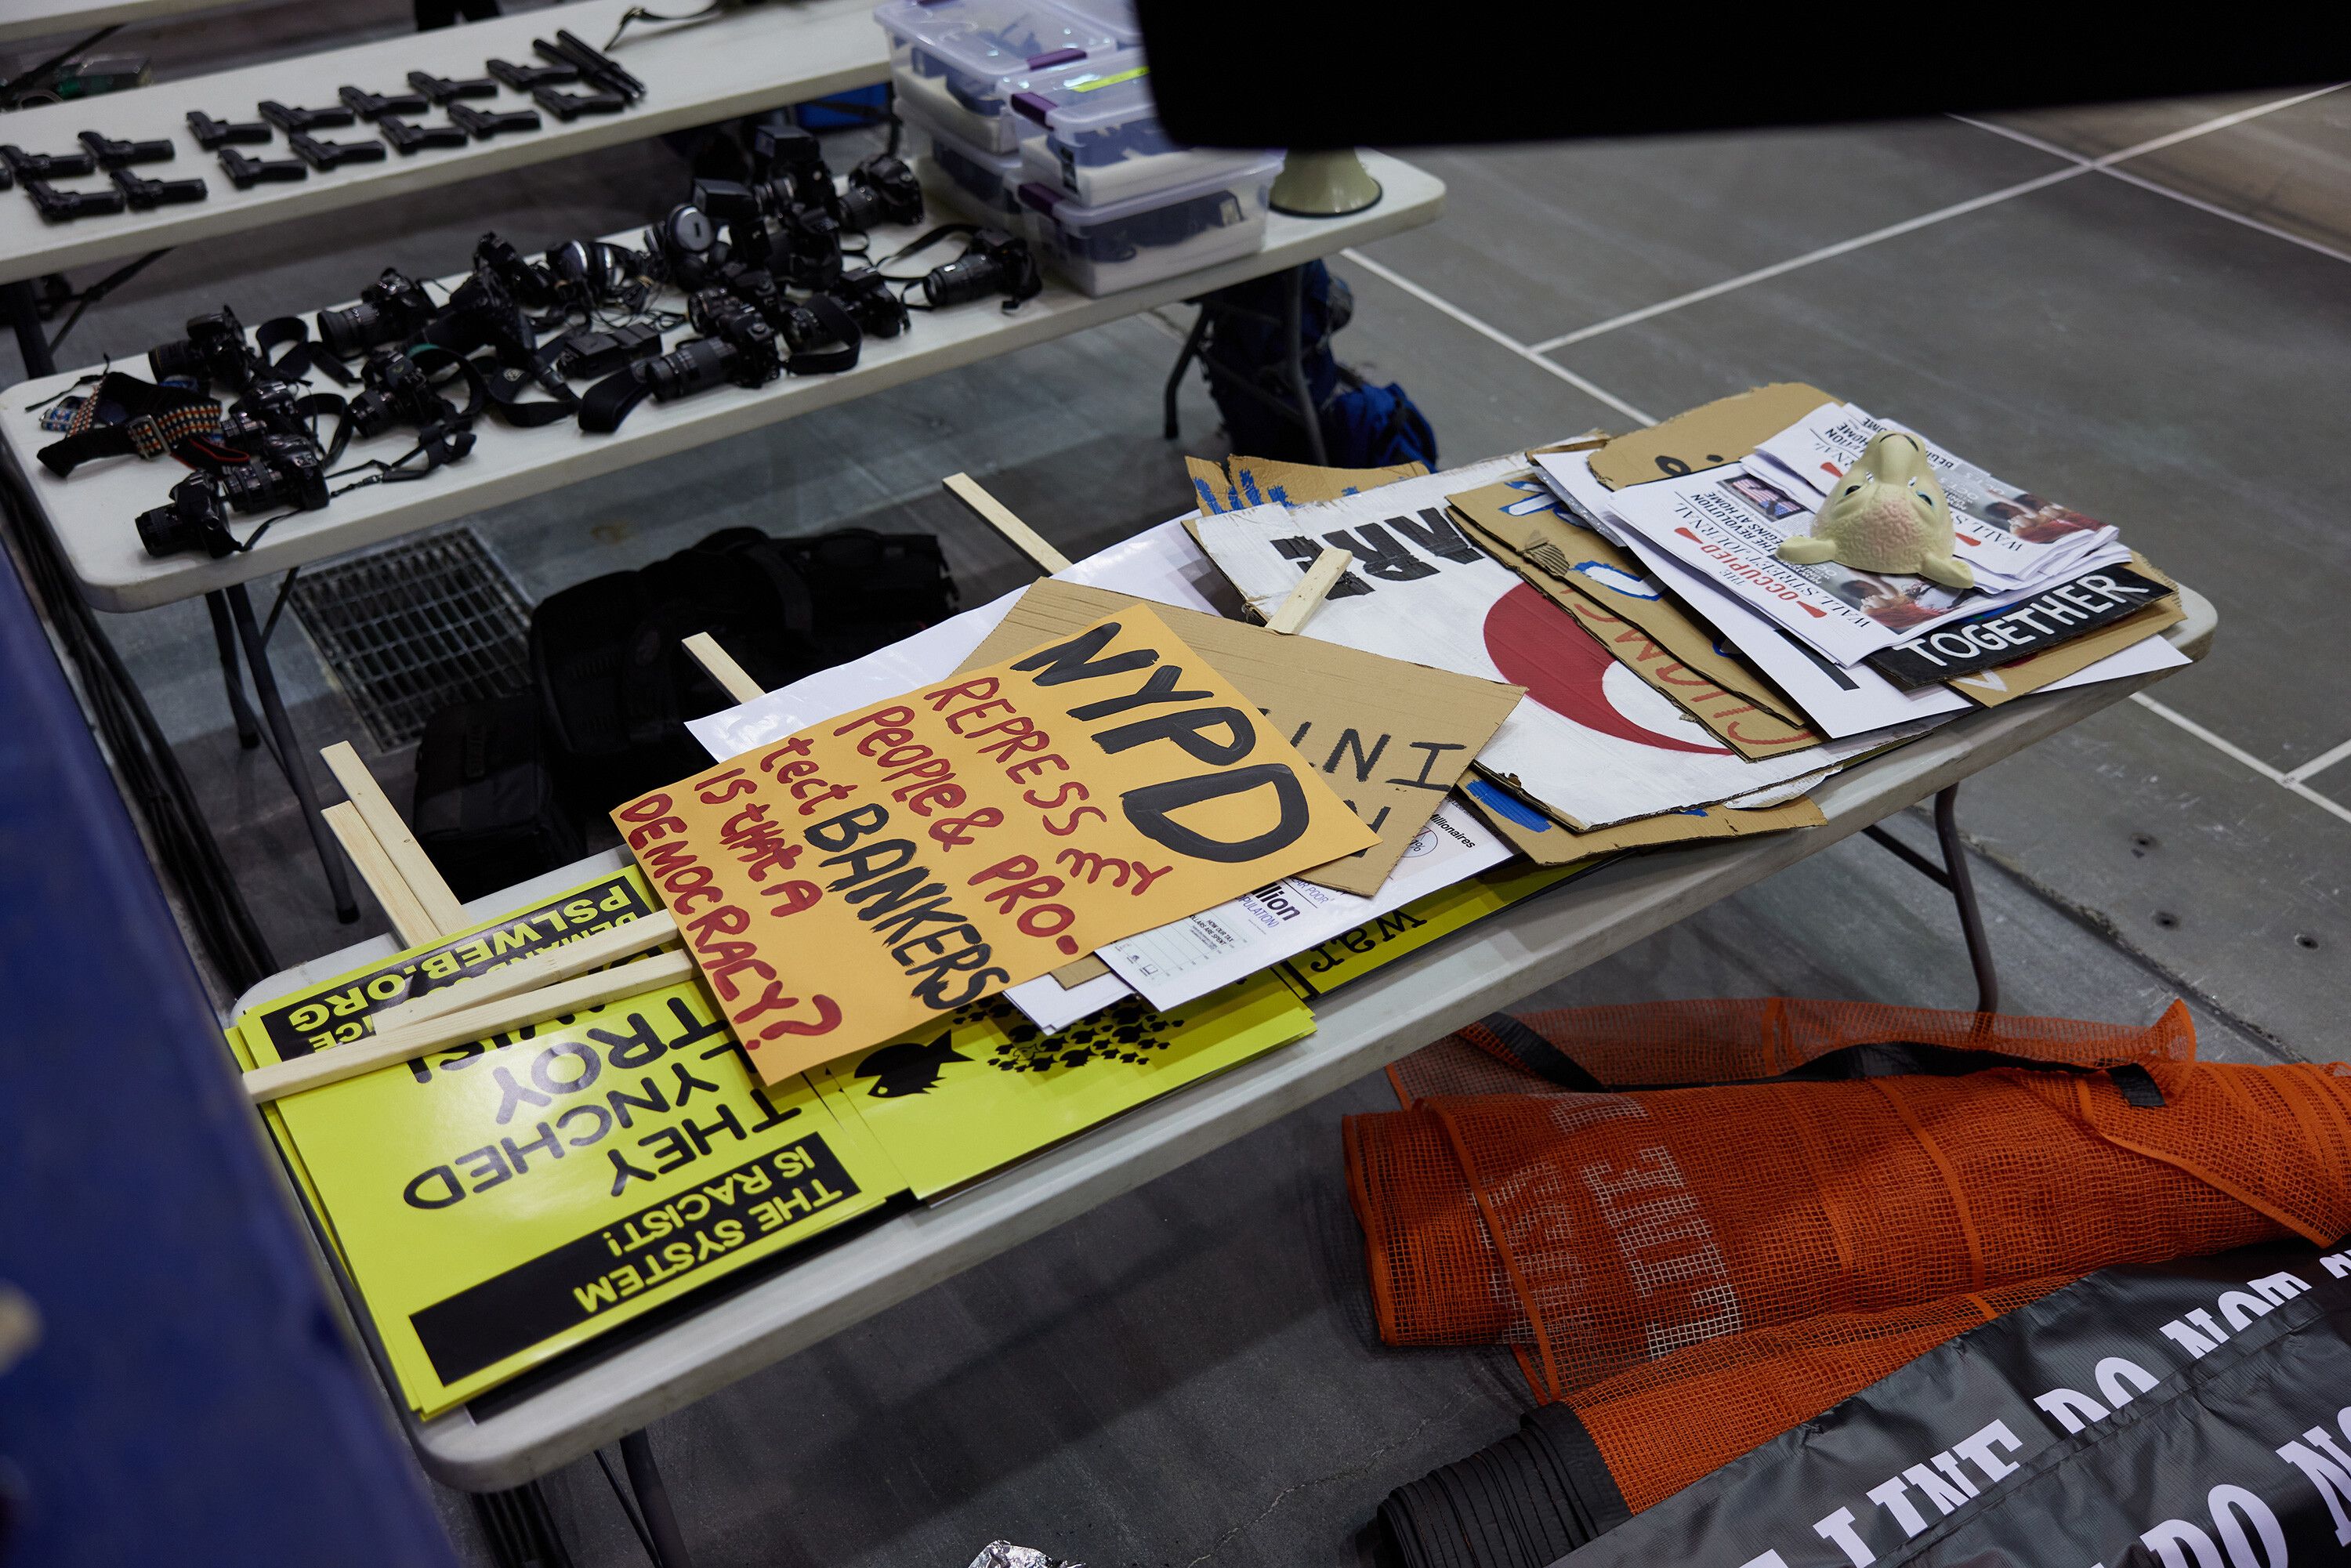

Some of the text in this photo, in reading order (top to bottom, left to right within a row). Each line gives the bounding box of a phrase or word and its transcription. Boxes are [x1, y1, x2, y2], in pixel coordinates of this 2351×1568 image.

[1674, 502, 1750, 554] JOURNAL
[1690, 494, 1755, 541] REVOLUTION
[1704, 491, 1738, 514] HOME
[1734, 513, 1750, 523] AT
[1748, 523, 1784, 546] EGINS
[1700, 544, 1799, 601] OCCUPIED
[1719, 569, 1745, 586] THE
[1744, 555, 1820, 596] STREET
[1754, 538, 1777, 553] THE
[1820, 596, 1871, 628] WALL
[1892, 574, 2150, 668] TOGETHER
[923, 676, 1107, 836] REPRESS
[1009, 621, 1310, 864] NYPD
[619, 793, 843, 1050] DEMOCRACY?
[803, 802, 1010, 1010] BANKERS
[967, 854, 1079, 955] PRO-
[1189, 914, 1206, 929] OLLARS
[1251, 882, 1301, 922] llion
[288, 884, 632, 1032] PSLWEB.ORG
[492, 997, 730, 1125] TROY
[403, 1040, 759, 1210] LYNCHED
[607, 1088, 802, 1198] THEY
[603, 1145, 816, 1257] IS RACIST!
[573, 1178, 843, 1313] THE SYSTEM
